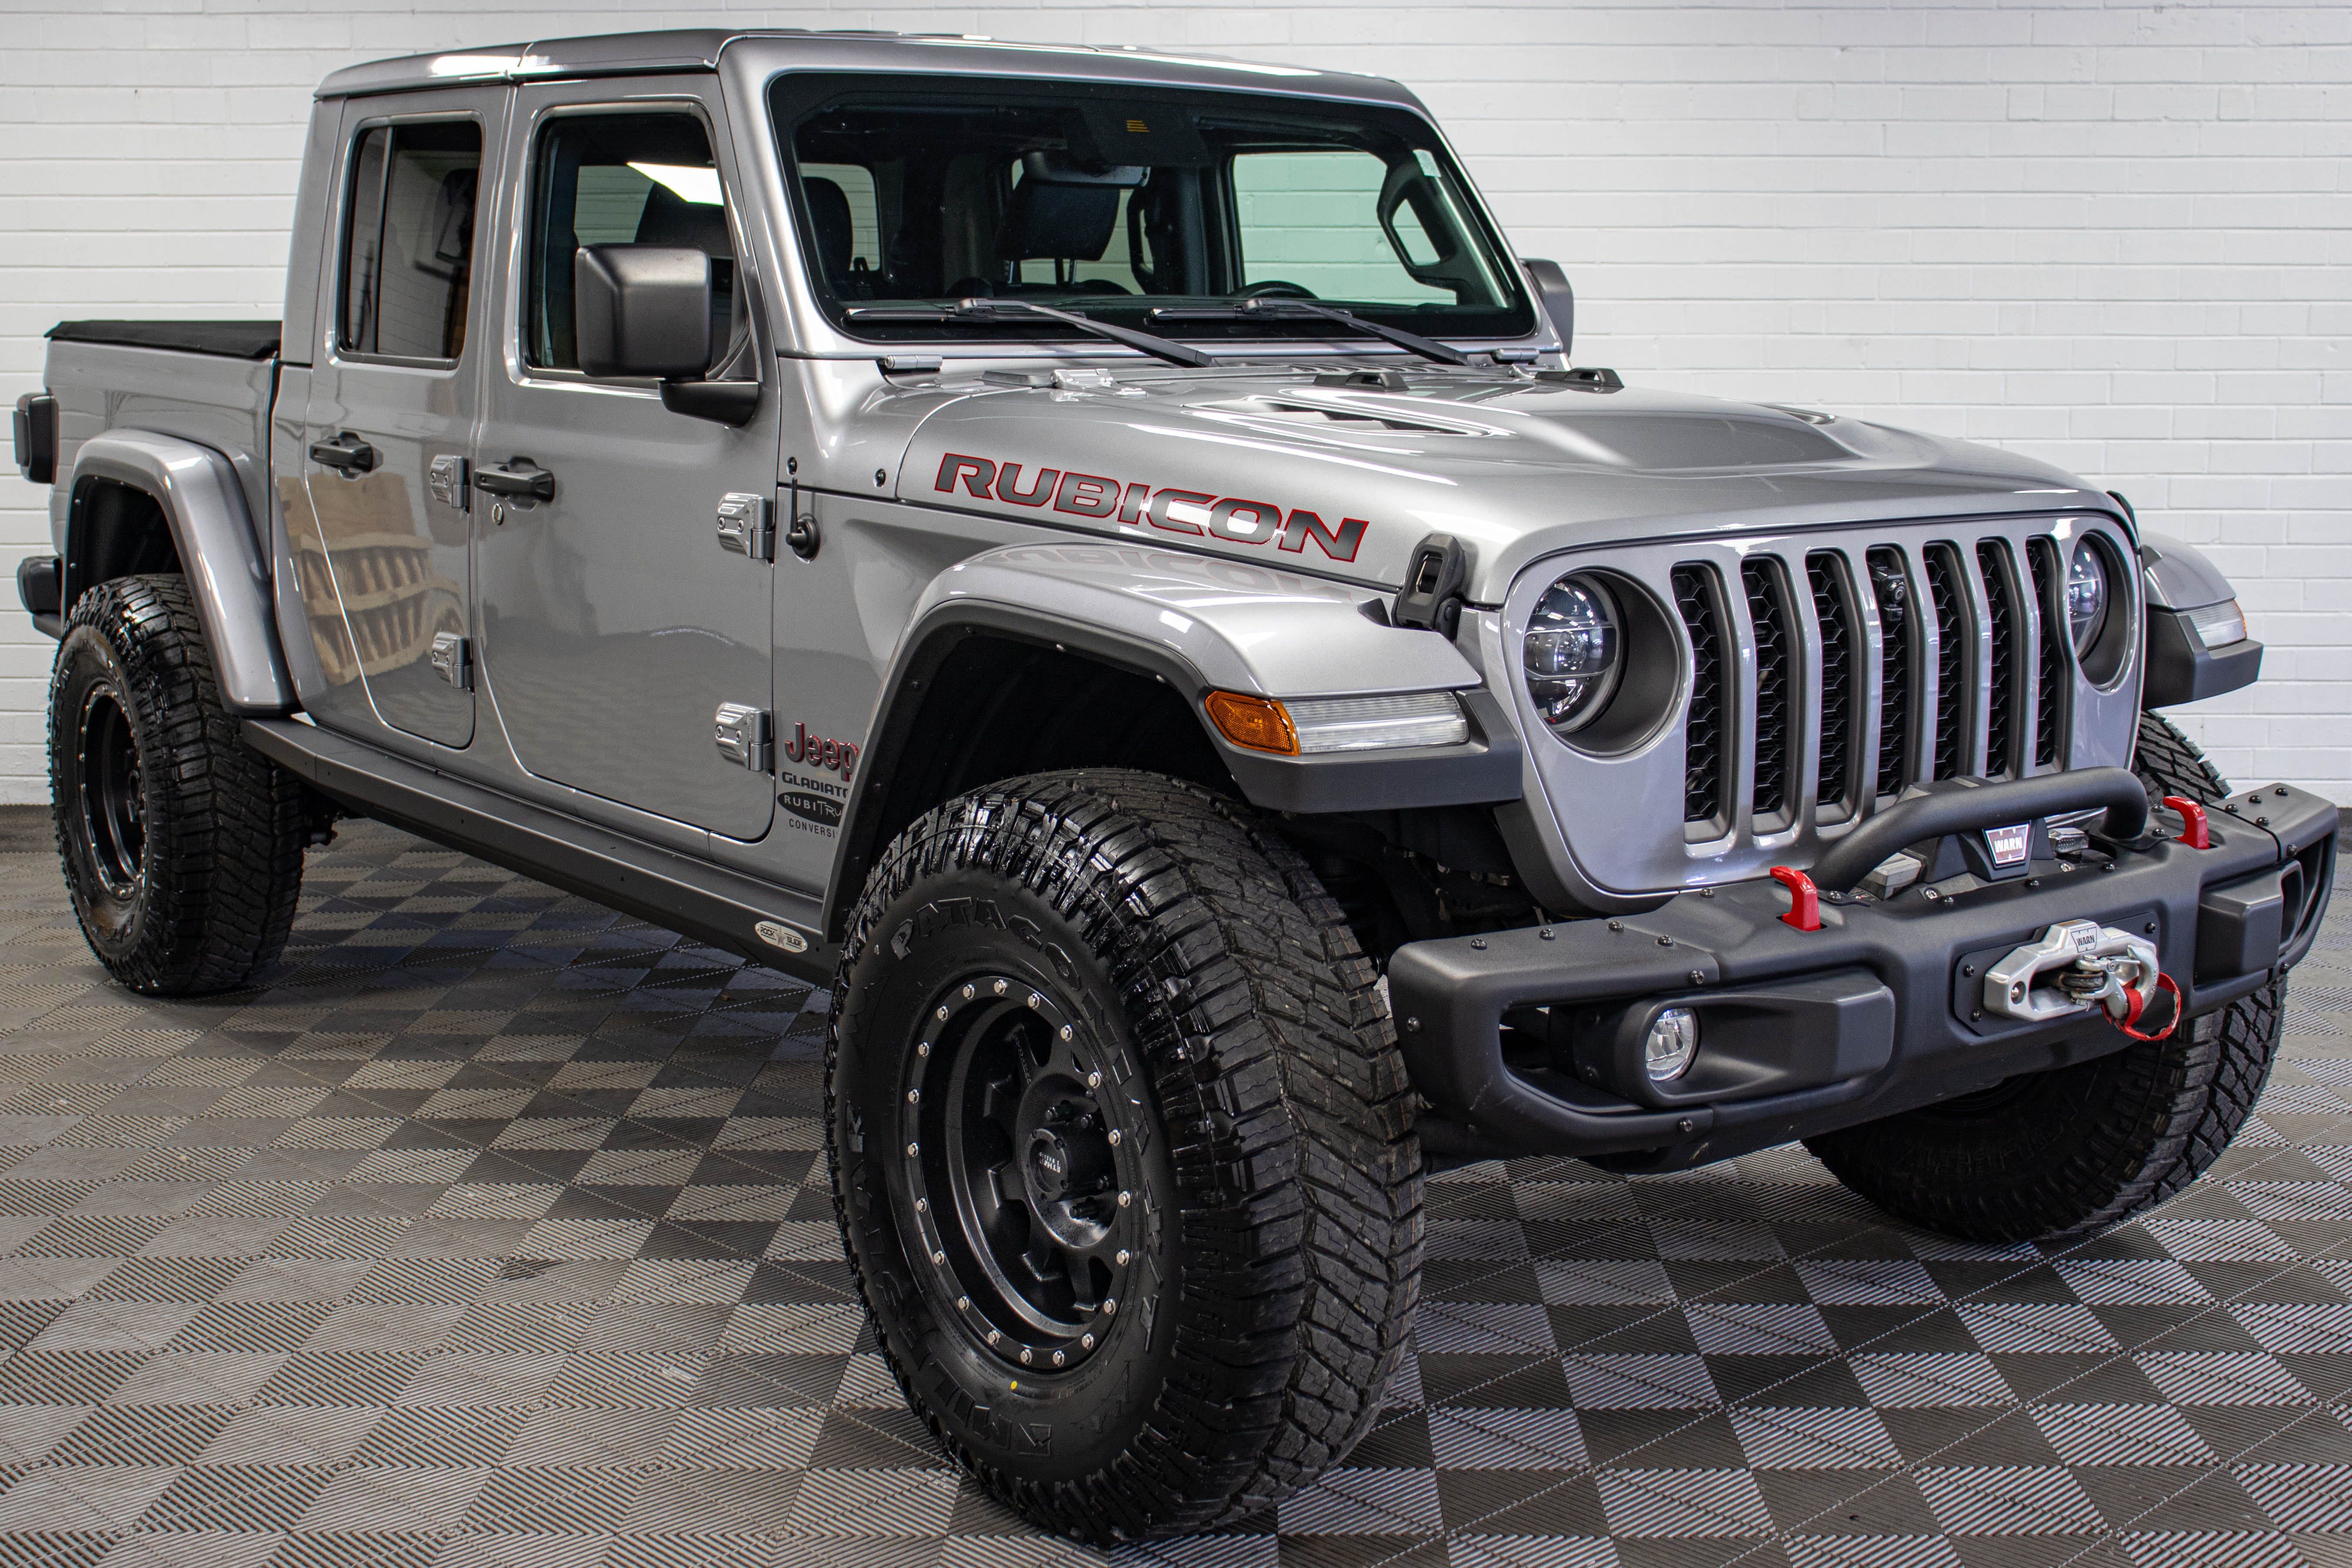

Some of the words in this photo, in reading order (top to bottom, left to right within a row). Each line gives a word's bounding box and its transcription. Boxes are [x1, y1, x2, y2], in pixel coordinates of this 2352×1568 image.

[934, 452, 1369, 563] RUBICON
[784, 722, 859, 782] Jeep
[789, 818, 838, 839] CONVERSI
[1994, 836, 2023, 853] WARN
[787, 936, 802, 947] SLIDE
[2076, 935, 2095, 946] WARN
[890, 896, 1150, 1156] PATAGONIA
